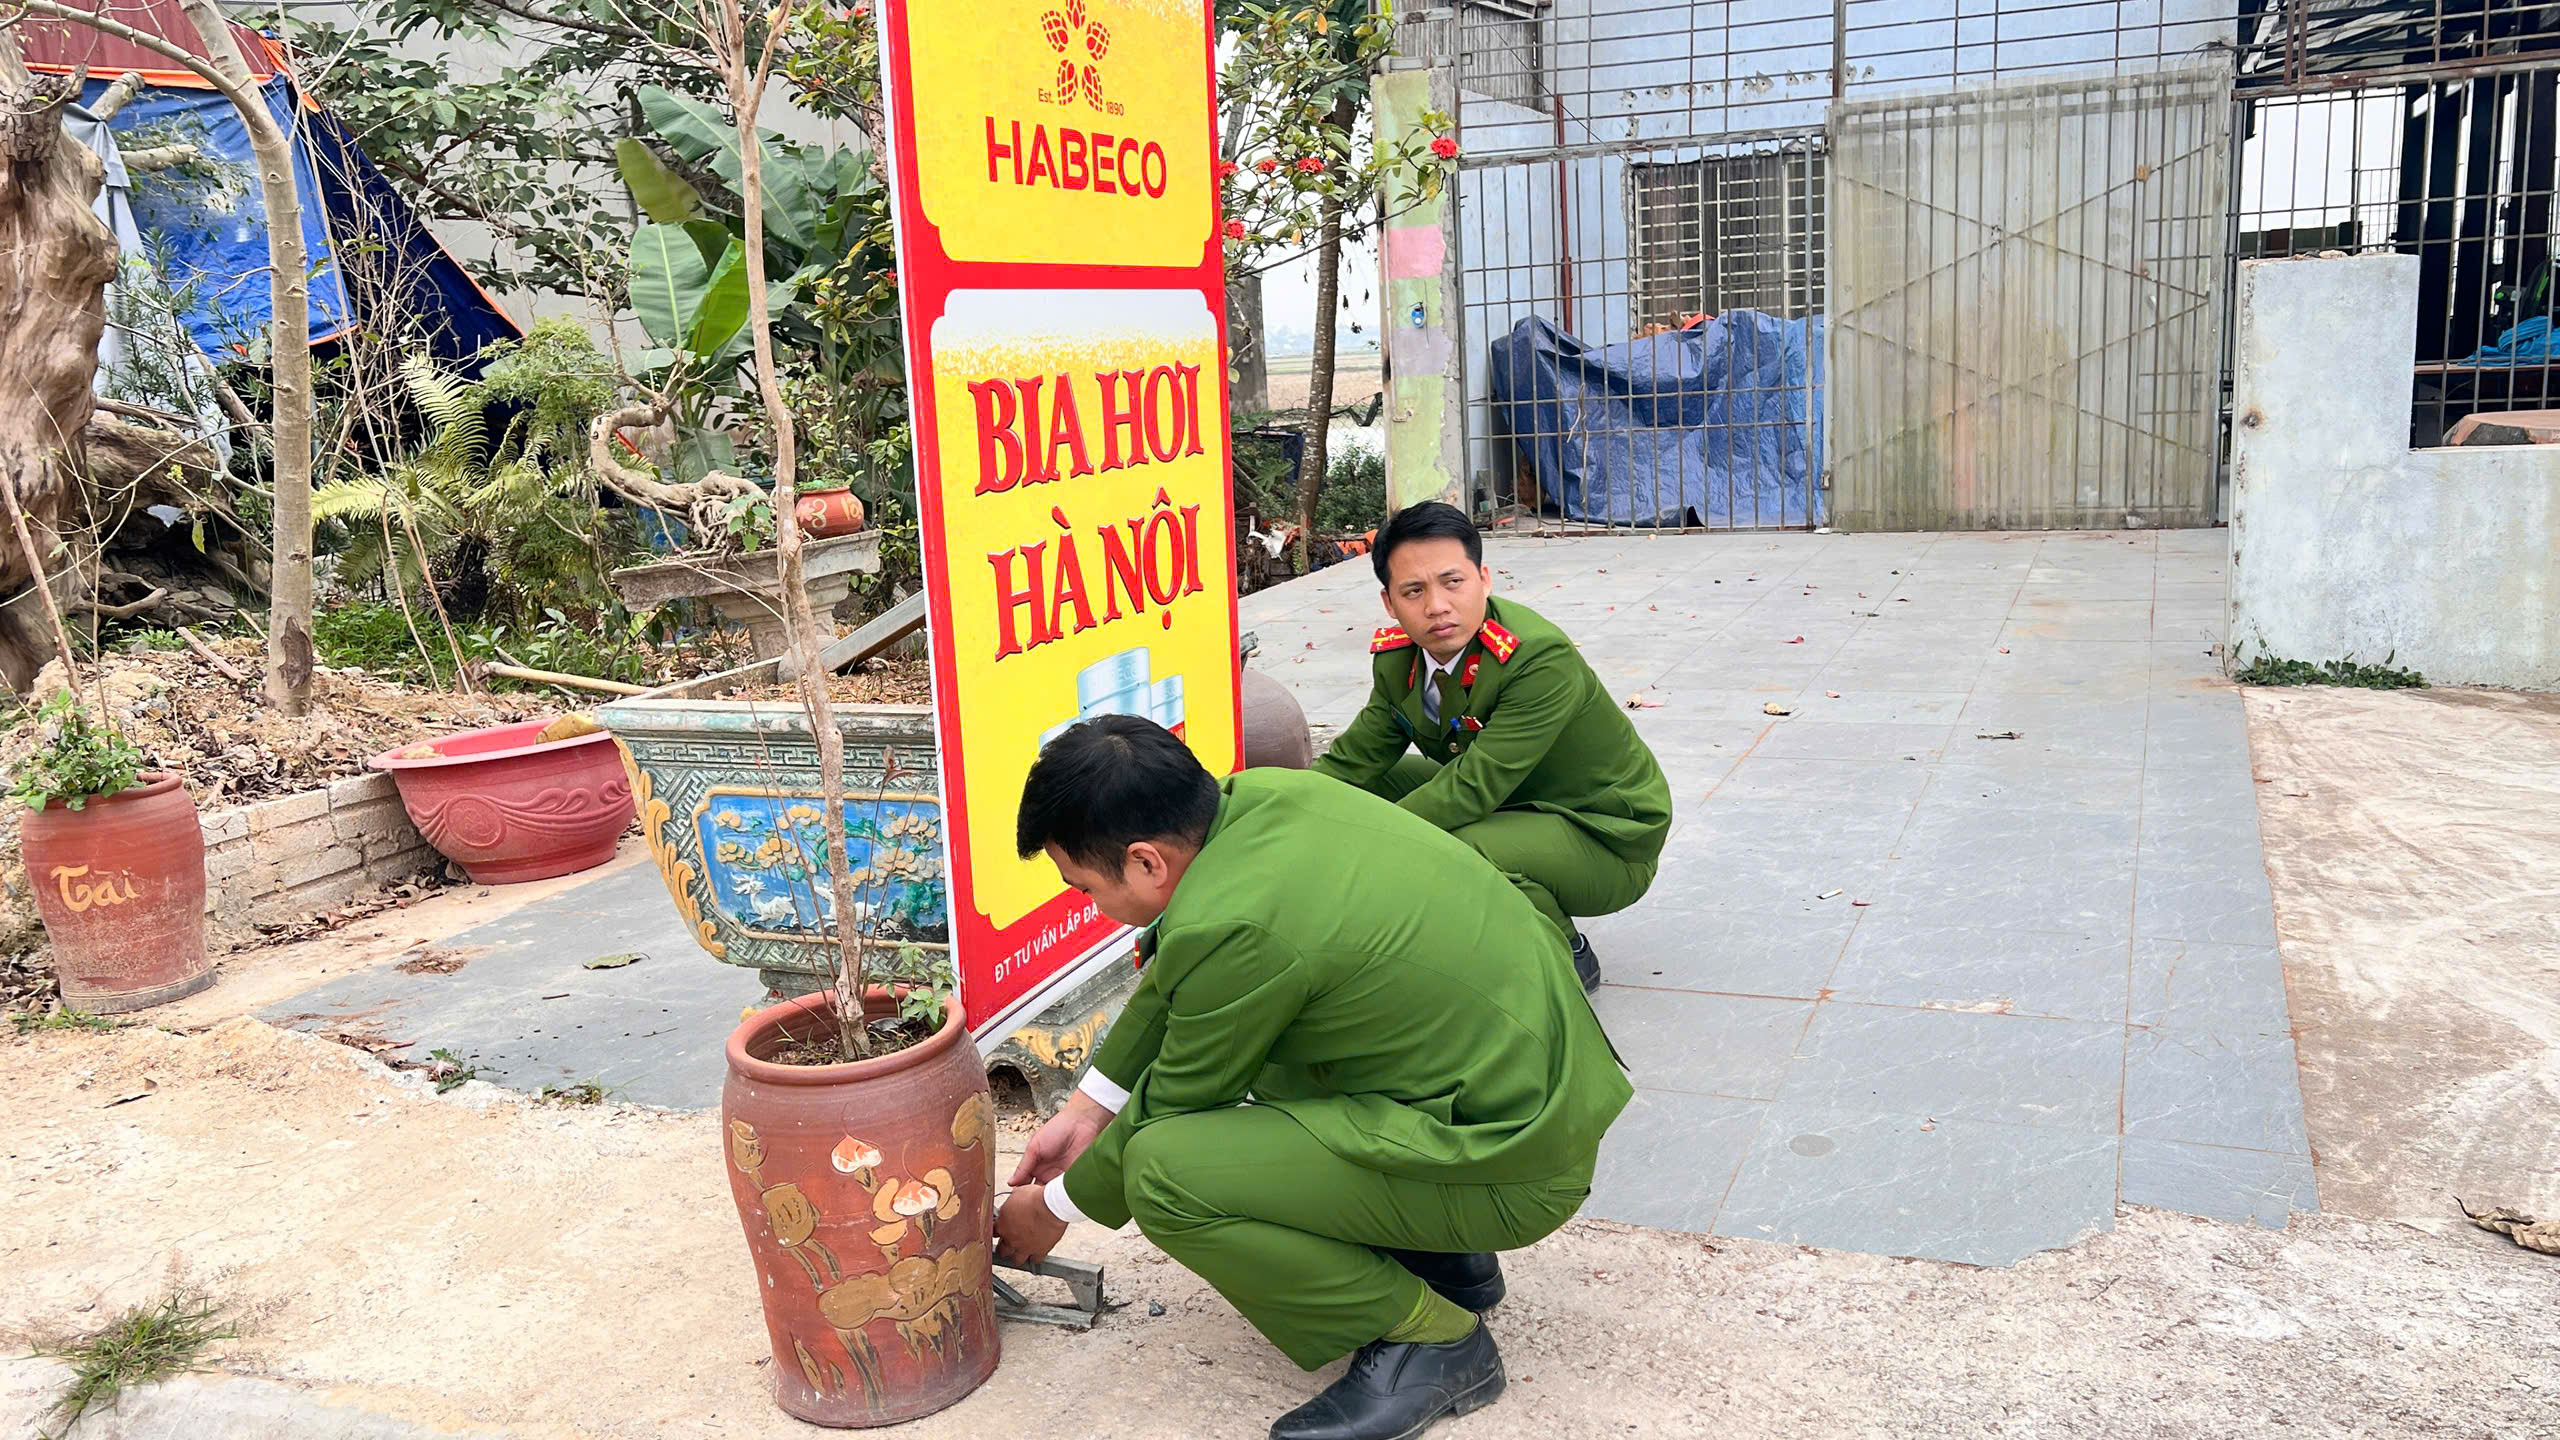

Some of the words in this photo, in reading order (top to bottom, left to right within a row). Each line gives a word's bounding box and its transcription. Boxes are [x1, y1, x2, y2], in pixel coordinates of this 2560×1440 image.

[1038, 88, 1054, 104] Est.
[1105, 101, 1125, 117] 1890
[985, 116, 1167, 199] HABECO
[967, 372, 1094, 497] BIA
[1095, 360, 1204, 473] HƠI
[987, 505, 1098, 662] HÀ
[1097, 486, 1204, 631] NỘI
[994, 956, 1012, 985] ĐT
[1013, 940, 1031, 969] TƯ
[1032, 923, 1057, 956] VẤN
